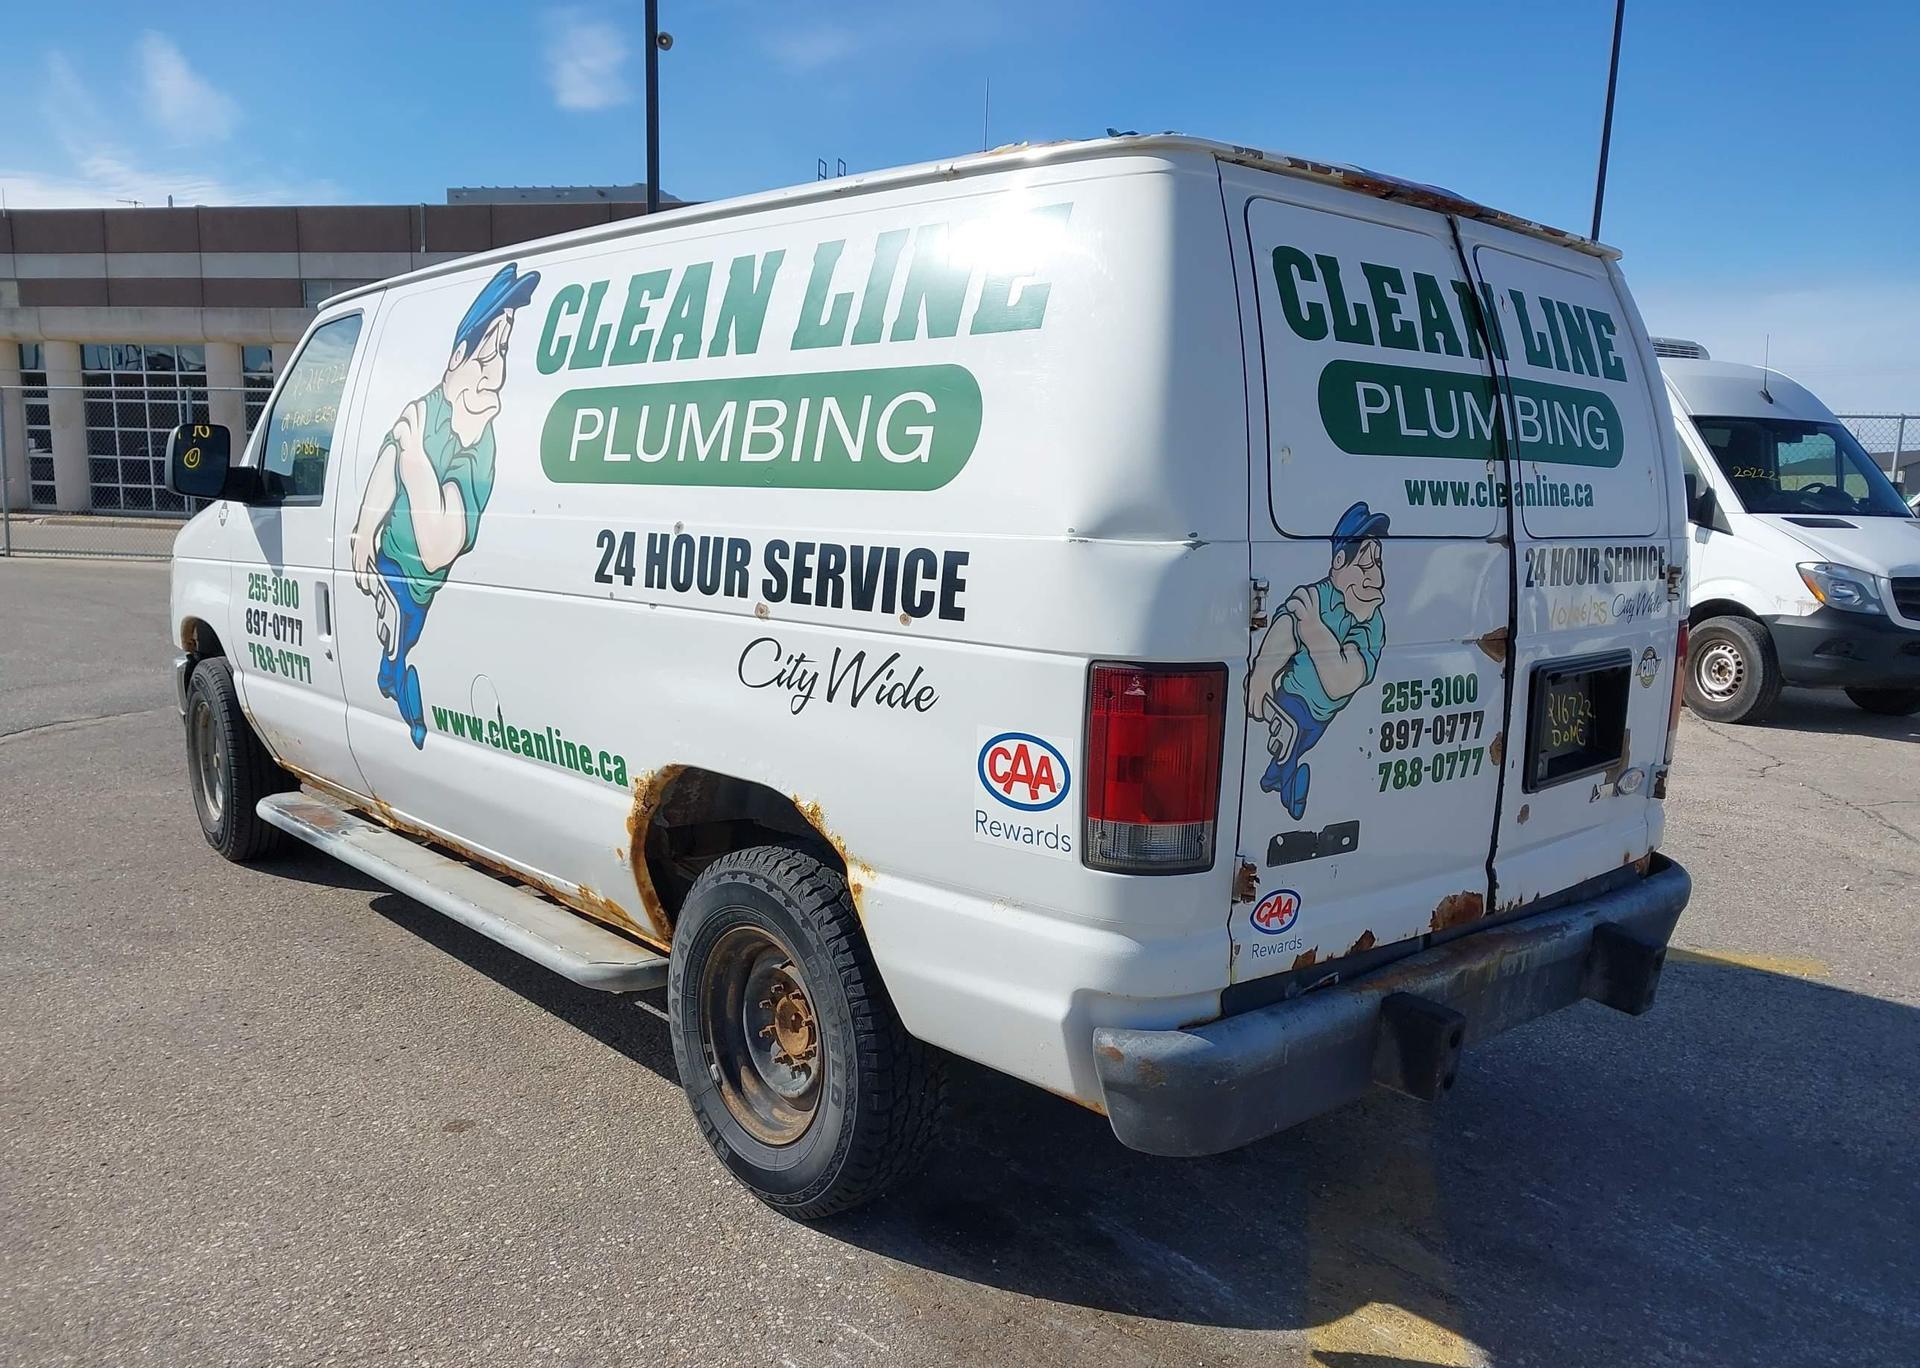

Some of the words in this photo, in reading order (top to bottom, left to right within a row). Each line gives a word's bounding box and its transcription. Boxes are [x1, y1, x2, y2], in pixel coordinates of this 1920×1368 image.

[536, 249, 786, 375] CLEAN
[1272, 245, 1509, 360] CLEAN
[1509, 289, 1628, 382] LINE
[568, 391, 938, 464] PLUMBING
[1355, 381, 1611, 451] PLUMBING
[1404, 474, 1594, 508] www.cleanline.ca
[594, 529, 636, 586] 24
[645, 532, 752, 599] HOUR
[761, 539, 970, 622] SERVICE
[1525, 547, 1546, 588] 24
[1549, 547, 1600, 587] HOUR
[1603, 545, 1666, 584] SERVICE
[248, 572, 299, 610] 255-3100
[1612, 593, 1635, 624] City
[1636, 591, 1663, 617] Wide
[246, 607, 303, 647] 897-0777
[248, 641, 312, 685] 788-0777
[738, 637, 819, 715] City
[826, 646, 940, 713] Wide
[1381, 672, 1478, 714] 255-3100
[431, 705, 629, 787] www.cleanline.ca
[1379, 710, 1485, 753] 897-0777
[988, 743, 1058, 801] CAA
[1378, 747, 1484, 793] 788-0777
[975, 809, 1072, 853] Rewards
[1256, 895, 1293, 928] CAA
[1251, 933, 1303, 959] Rewards
